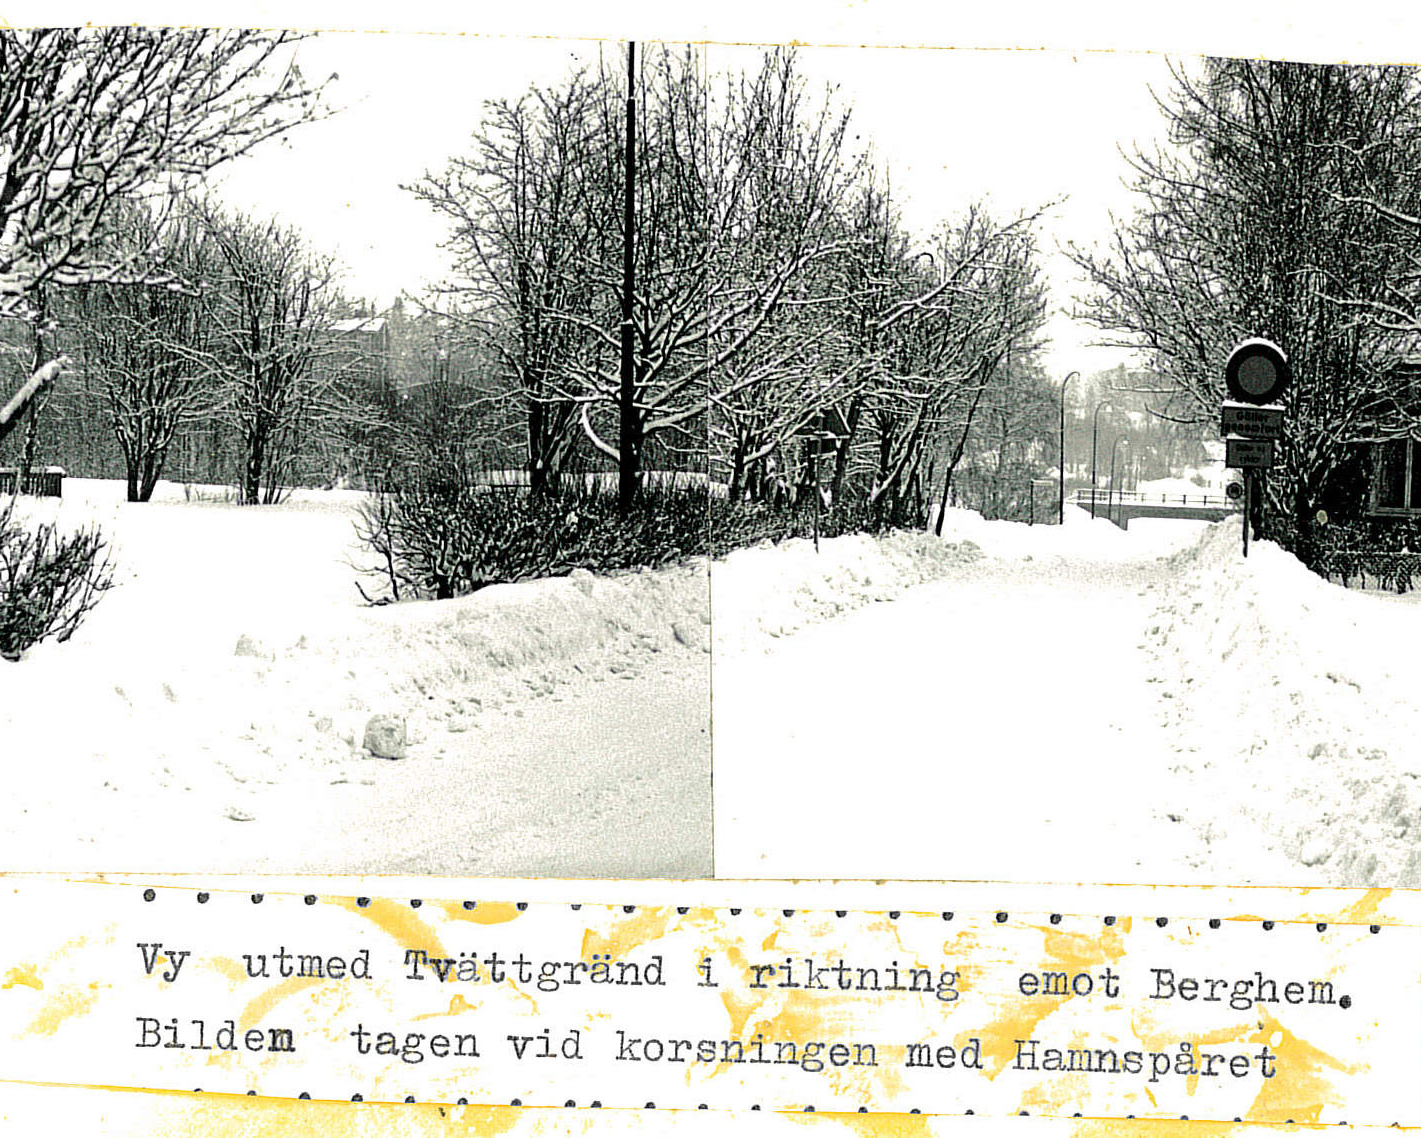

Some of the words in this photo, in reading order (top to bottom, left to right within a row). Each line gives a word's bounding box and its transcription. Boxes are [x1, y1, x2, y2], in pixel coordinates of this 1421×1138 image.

[136, 942, 191, 983] Vy
[242, 946, 373, 980] utmed
[403, 949, 666, 993] Tvättgränd
[697, 957, 719, 988] i
[749, 957, 961, 1002] riktning
[1018, 967, 1120, 999] emot
[1149, 968, 1352, 1011] Berghem.
[135, 1017, 296, 1053] Bilden
[350, 1023, 480, 1065] tagen
[506, 1028, 584, 1060] vid
[615, 1030, 879, 1073] korsningen
[905, 1038, 984, 1070] med
[1012, 1039, 1276, 1083] Hamnspåret
